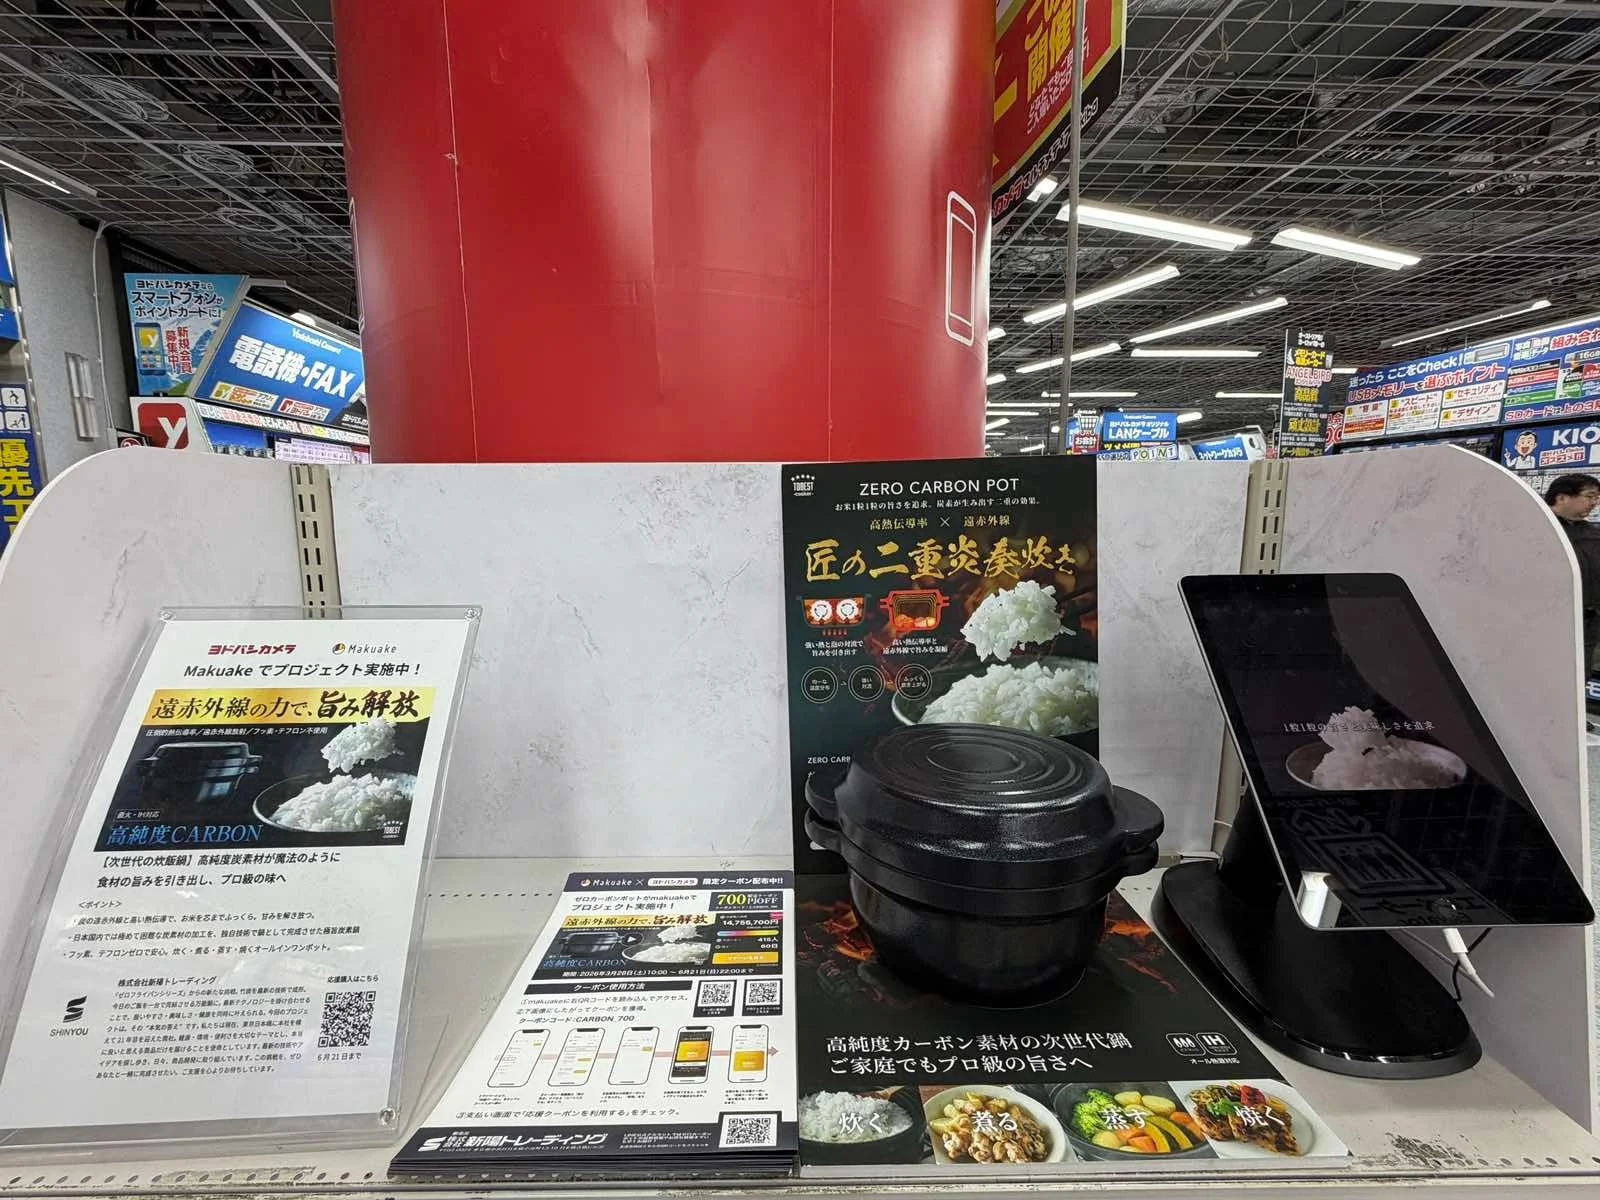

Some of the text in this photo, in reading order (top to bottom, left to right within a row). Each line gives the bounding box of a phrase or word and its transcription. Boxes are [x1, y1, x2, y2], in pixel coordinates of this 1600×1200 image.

[229, 335, 355, 398] 電話機・FAX
[1286, 366, 1332, 382] ANGELBIRD
[1075, 437, 1097, 446] お会計
[1109, 428, 1170, 439] LANケーブル
[793, 481, 814, 492] TOBEST
[859, 478, 1020, 496] ZERO CARBON POT
[870, 517, 928, 531] 高熱伝導率
[963, 515, 1011, 527] 遠赤外線
[805, 534, 1076, 581] 匠の二重炎奏炊き
[207, 643, 397, 656] ヨドバシカメラ Makuake
[183, 662, 421, 677] Makuake でプロジェクト実施中!
[151, 689, 420, 720] 遠赤外線の力で、旨み解放
[106, 824, 264, 846] 高純度CARBON
[103, 852, 341, 868] 【次世代の炊飯鍋】高純度炭素材が魔法のように
[97, 873, 287, 889] 食材の旨みを引き出し、プロ級の味へ
[592, 879, 632, 887] Makuake
[571, 902, 675, 911] プロジェクト実施中!
[717, 893, 778, 905] 700 円OFF
[567, 914, 709, 927] 遠赤外線の力で、旨み解放
[118, 976, 218, 987] 株式会社新陽トレーディング
[574, 982, 646, 991] クーポン使用方法
[50, 1027, 89, 1038] SHINYOU
[1201, 1035, 1226, 1046] IH
[825, 1031, 1133, 1053] 高純度カーボン素材の次世代鍋
[829, 1054, 1094, 1075] ご家庭でもプロ級の旨さへ
[838, 1111, 884, 1135] 炊く
[970, 1111, 1018, 1132] 煮る
[1102, 1105, 1149, 1130] 蒸す
[1234, 1105, 1288, 1128] 焼く
[464, 1134, 608, 1147] 新陽トレーディング
